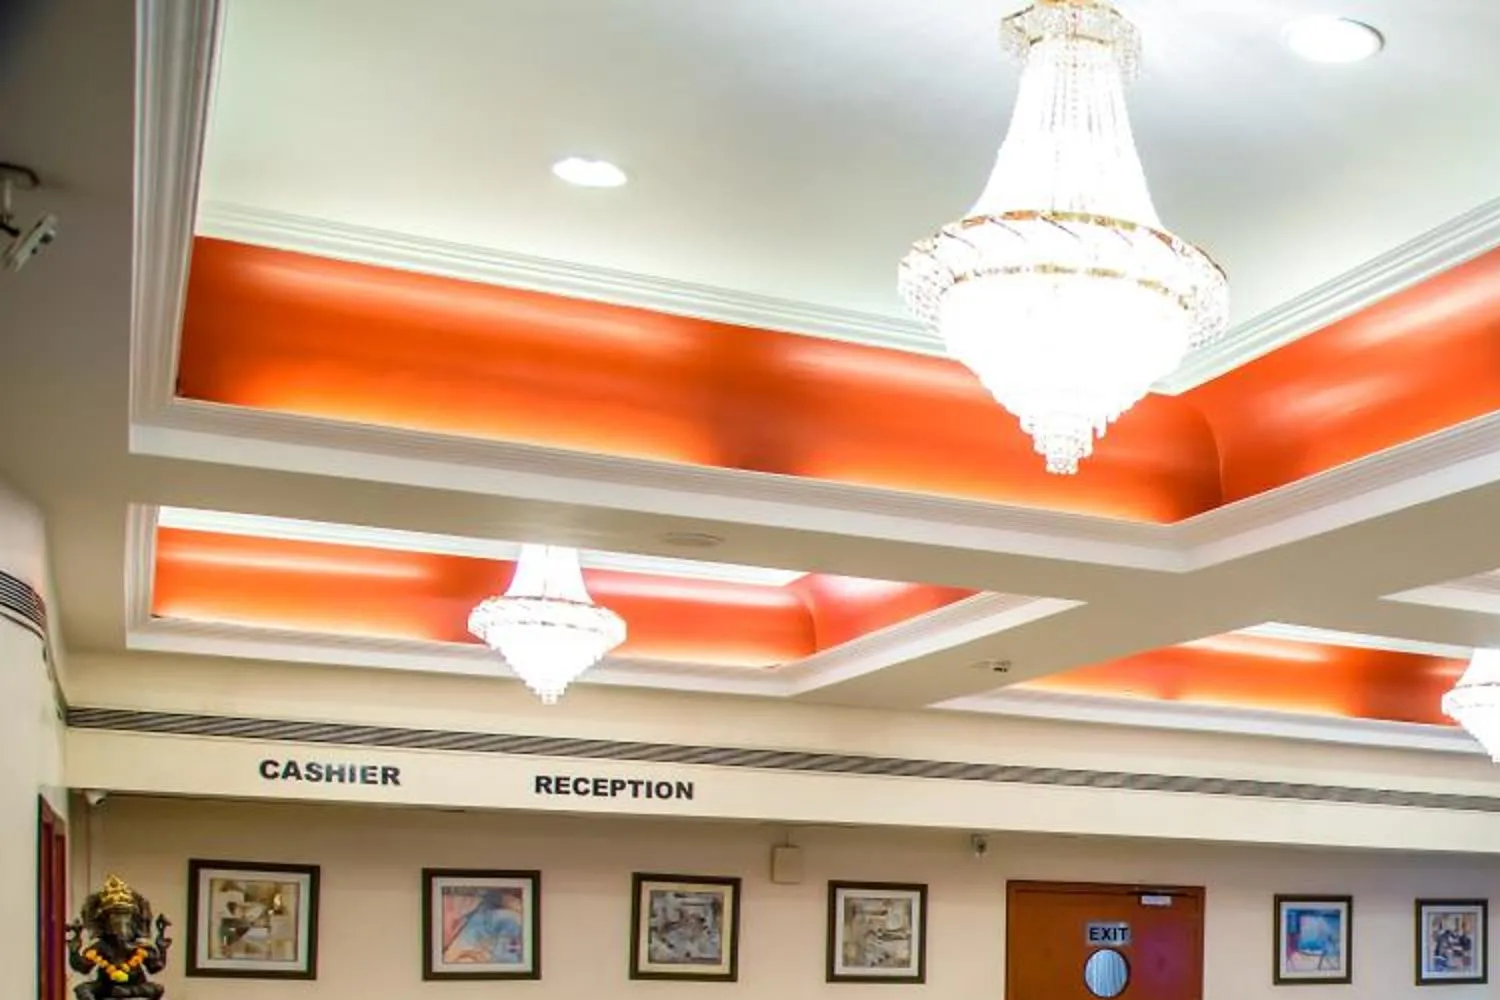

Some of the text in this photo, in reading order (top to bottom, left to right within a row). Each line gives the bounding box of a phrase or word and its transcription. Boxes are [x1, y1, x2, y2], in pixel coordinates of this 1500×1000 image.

[259, 759, 401, 786] CASHIER
[535, 775, 694, 800] RECEPTION
[1089, 927, 1128, 941] EXIT
